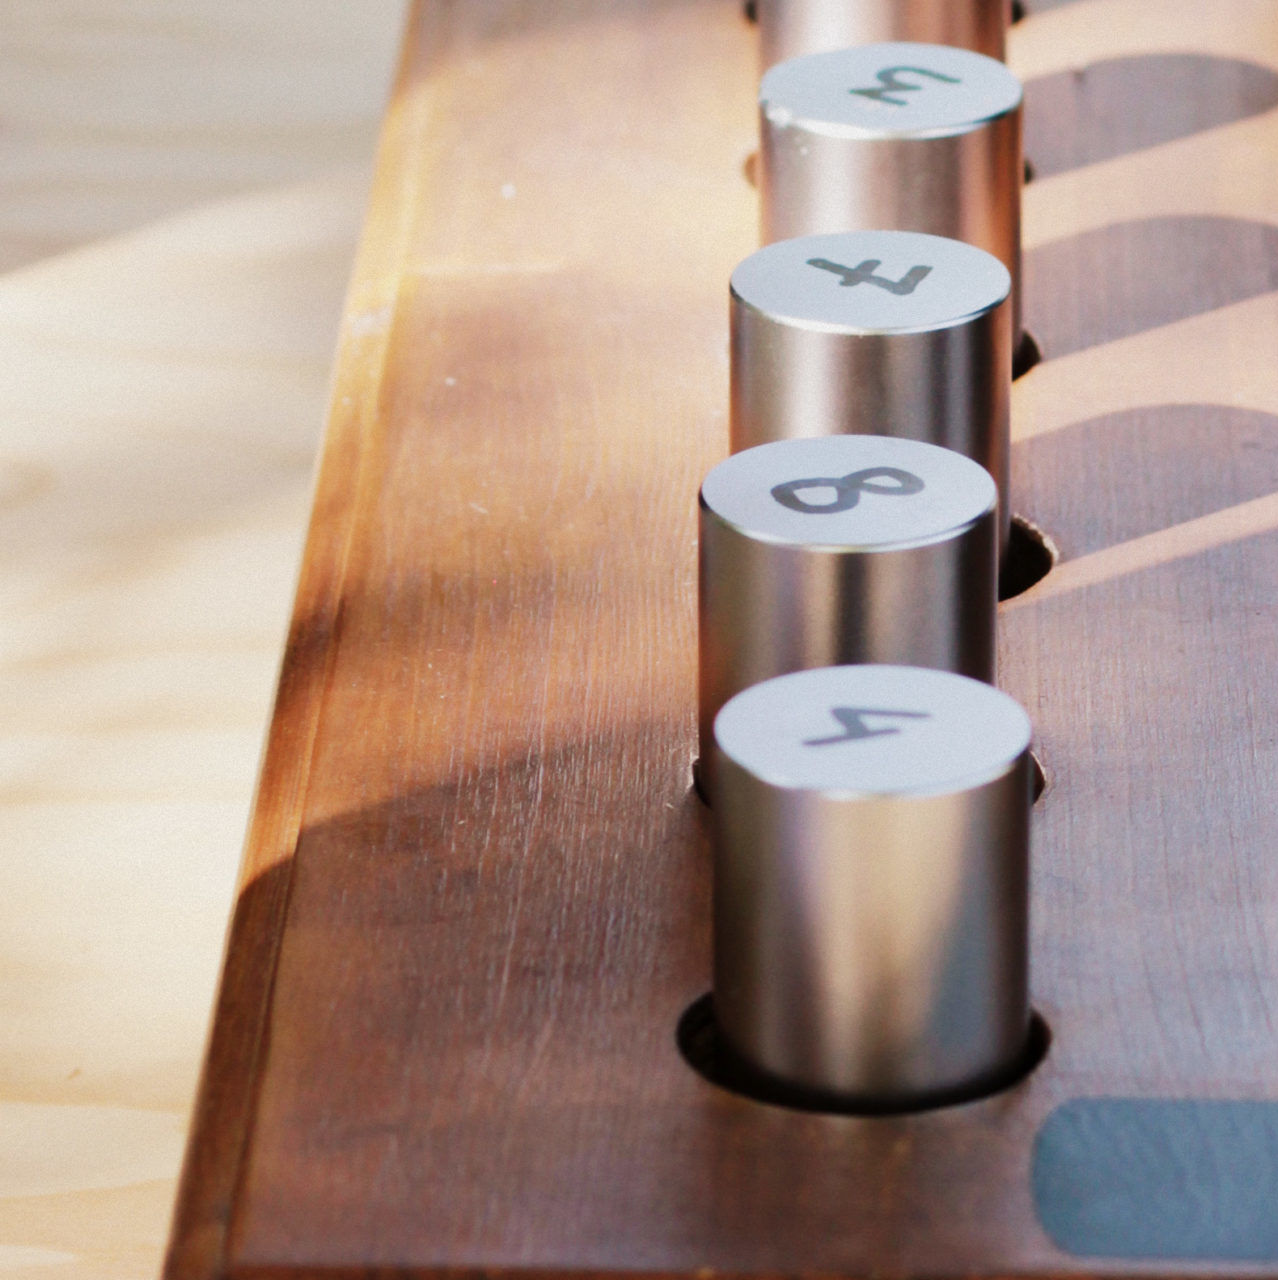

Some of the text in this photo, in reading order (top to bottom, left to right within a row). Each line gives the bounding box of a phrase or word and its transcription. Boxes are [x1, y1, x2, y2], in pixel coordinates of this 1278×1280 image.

[806, 256, 932, 296] 7
[769, 465, 924, 515] 8
[803, 705, 930, 747] 4
